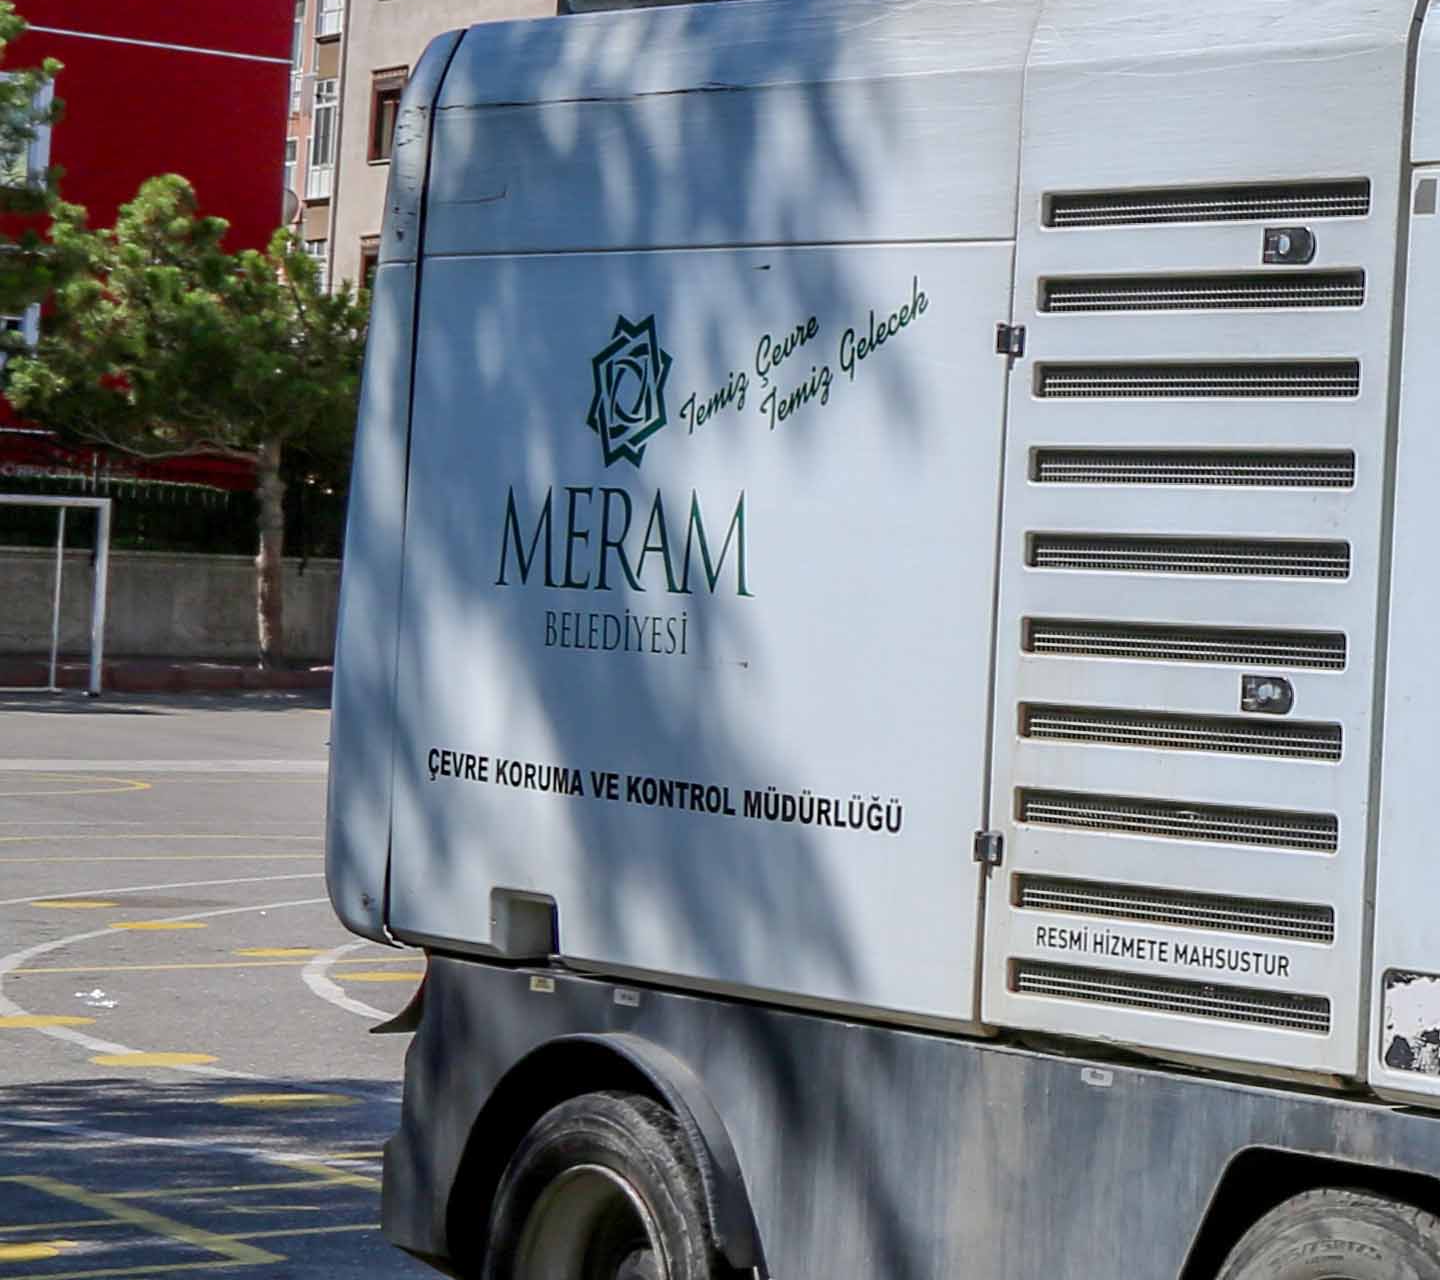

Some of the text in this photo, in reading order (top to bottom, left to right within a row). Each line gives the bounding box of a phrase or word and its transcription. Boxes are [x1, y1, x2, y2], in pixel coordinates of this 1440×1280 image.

[680, 312, 819, 436] Temiz Çevre
[760, 275, 929, 431] Temiz Gelecek
[495, 485, 754, 598] MERAM
[544, 607, 688, 655] BELEDİYESİ
[427, 748, 902, 834] ÇEVRE KORUMA VE KONTROL MÜDÜRLÜĞÜ
[1036, 924, 1289, 977] RESMİ HİZMETE MAHSUSTUR
